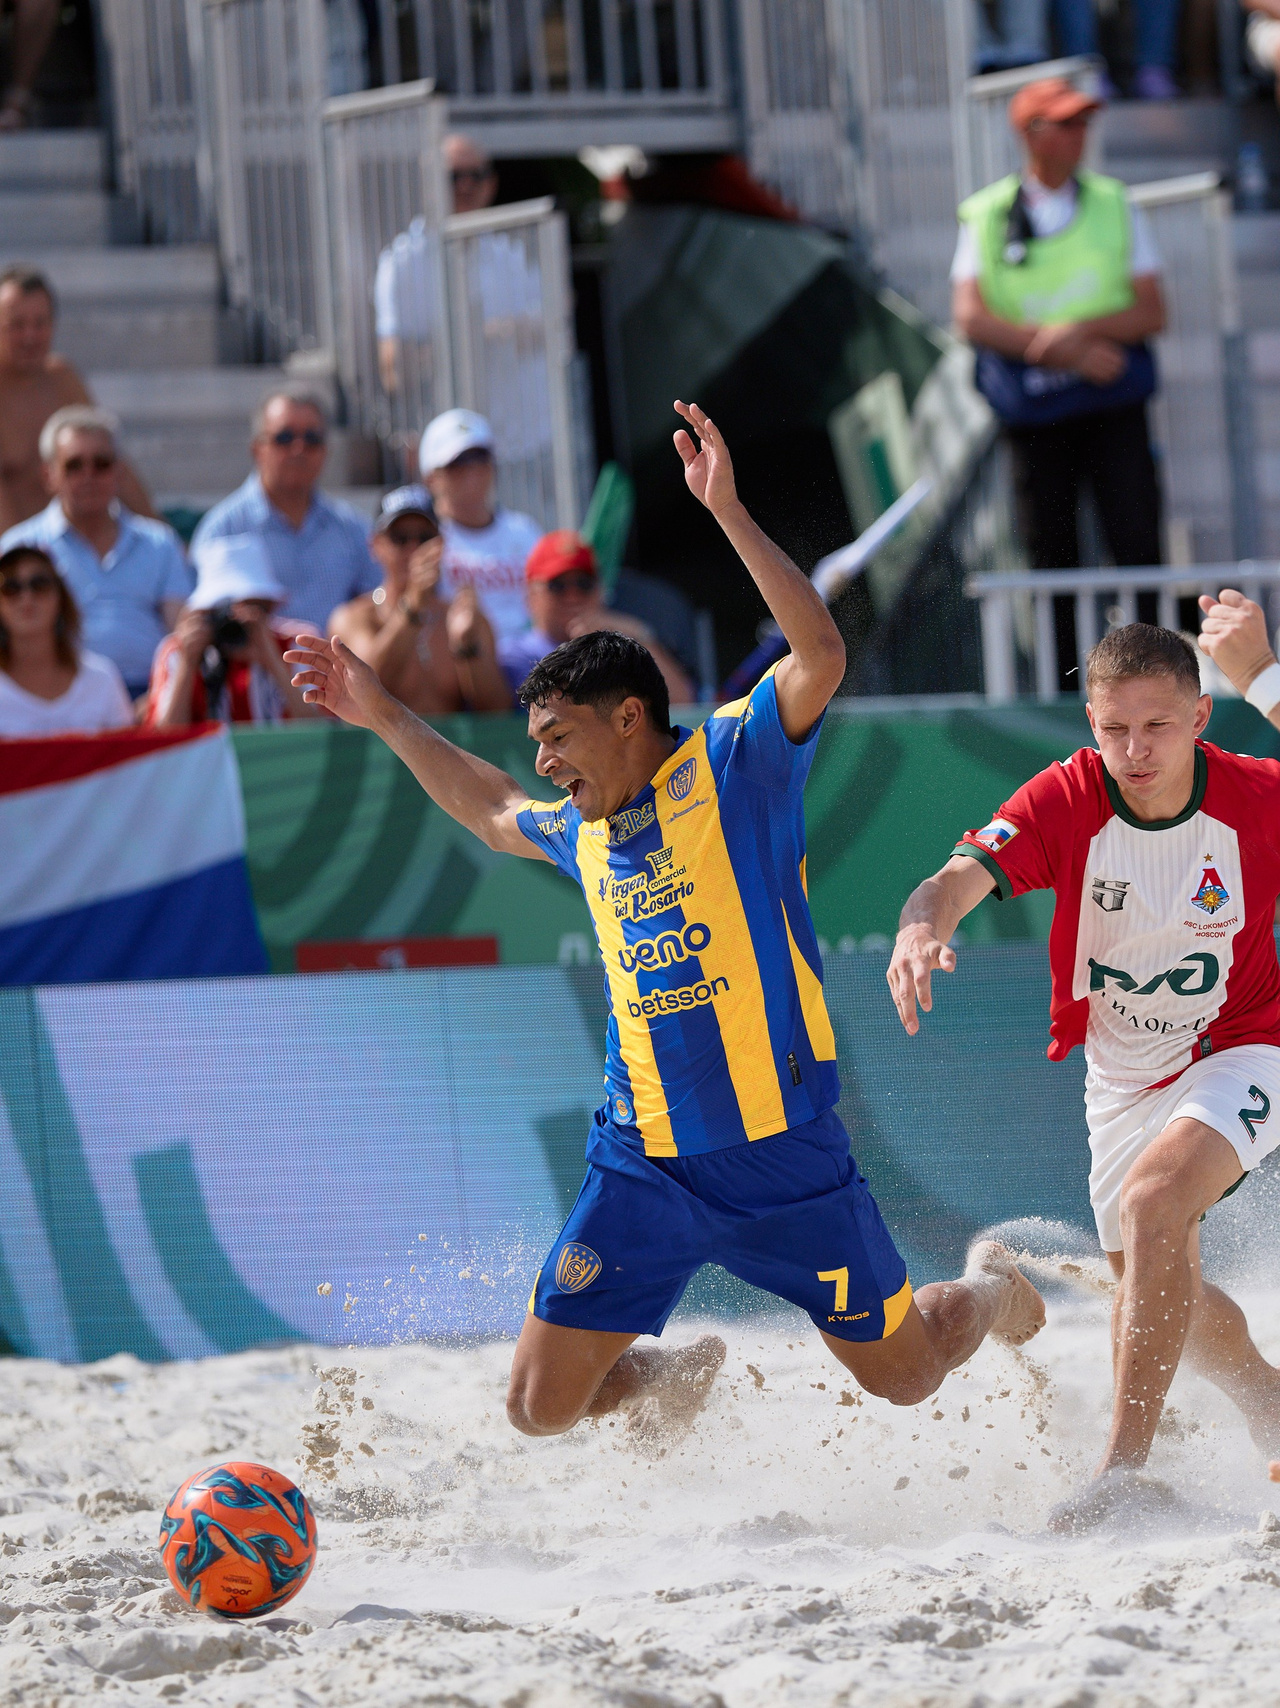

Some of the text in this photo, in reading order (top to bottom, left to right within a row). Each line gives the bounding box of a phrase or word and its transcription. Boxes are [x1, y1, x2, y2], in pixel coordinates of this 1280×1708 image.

[598, 864, 687, 902] Virgen comercial
[631, 881, 695, 920] Rosario
[1183, 916, 1239, 931] BSC LOKOMOTIV
[626, 976, 731, 1018] betsson
[1237, 1084, 1272, 1144] 2
[816, 1265, 850, 1312] 7
[827, 1311, 870, 1323] KYRIOS
